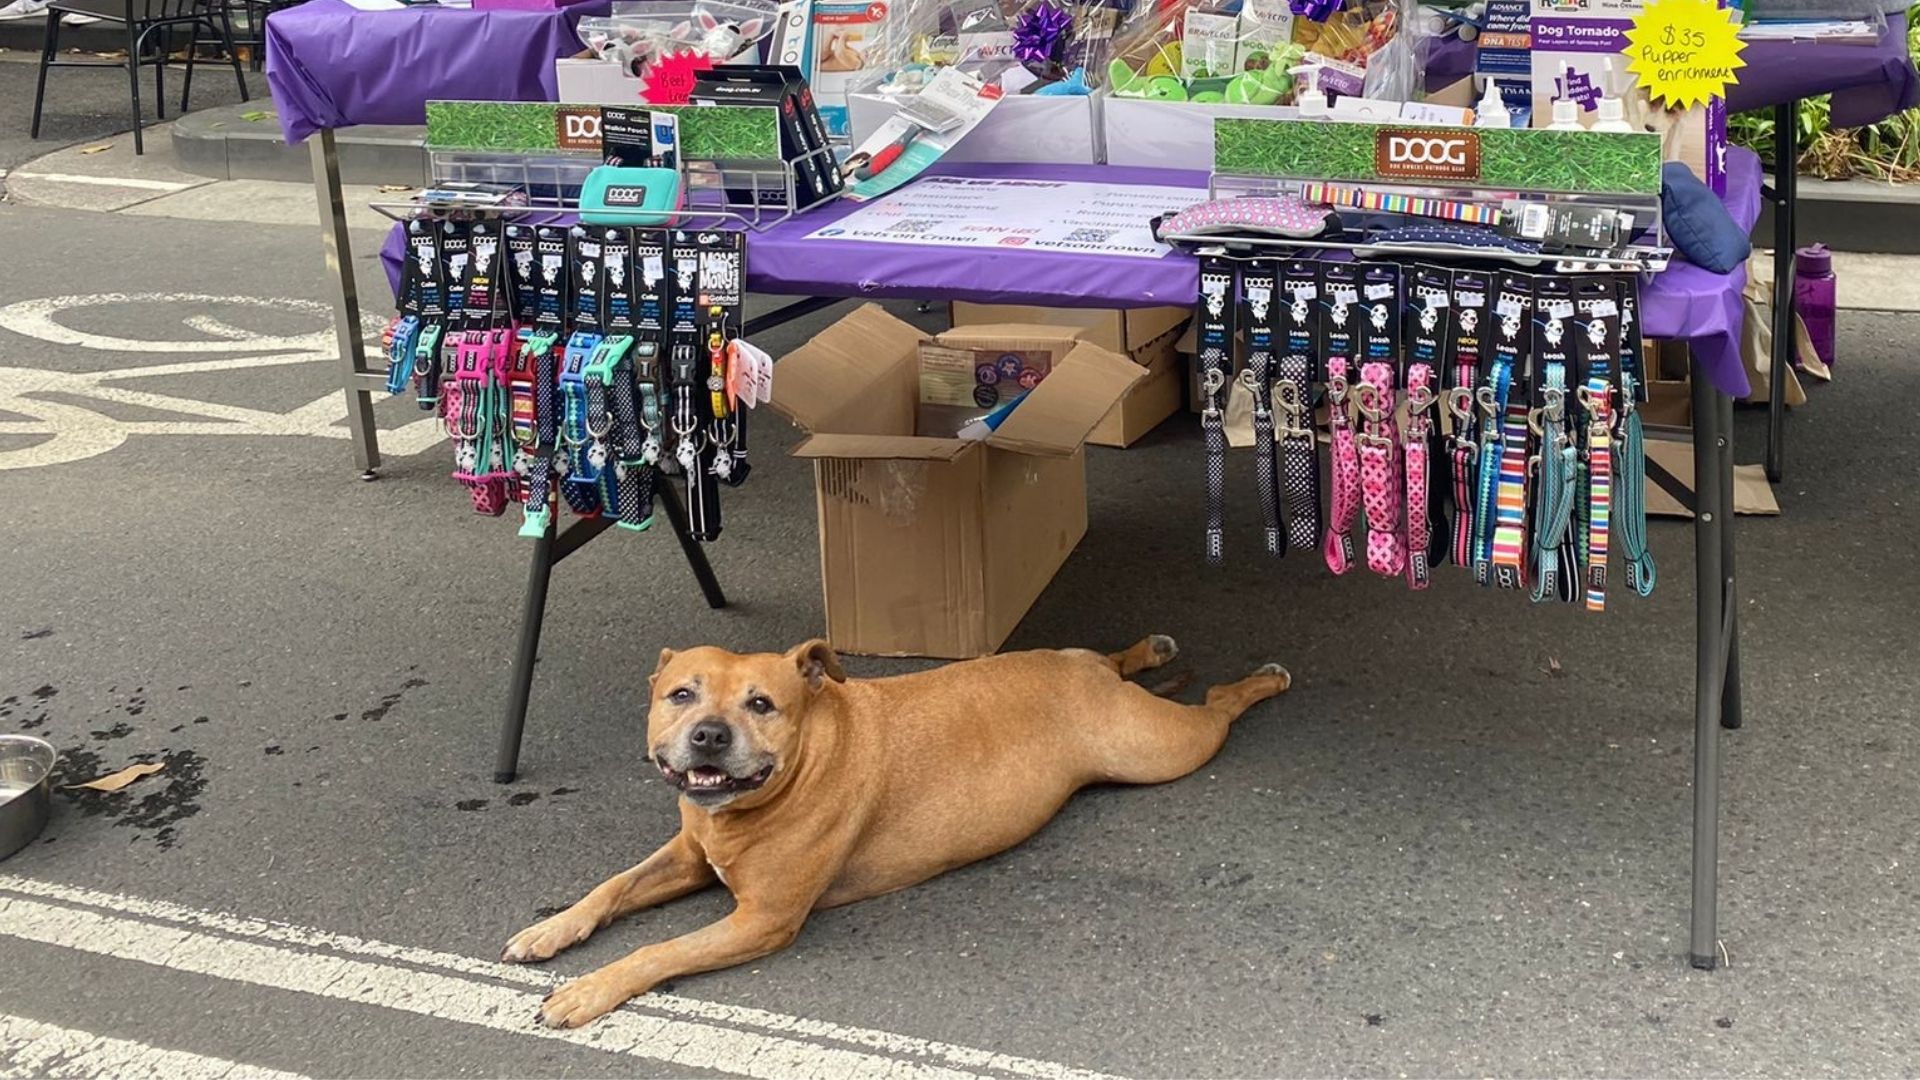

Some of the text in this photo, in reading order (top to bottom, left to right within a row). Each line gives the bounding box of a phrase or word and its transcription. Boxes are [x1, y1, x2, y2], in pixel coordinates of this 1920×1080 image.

[1489, 14, 1515, 22] Where
[1538, 25, 1619, 37] Dog Tornado
[1483, 37, 1505, 46] DNA
[1643, 45, 1697, 65] Pupper
[1657, 67, 1730, 81] enrichment
[604, 124, 648, 135] Walkie Pouch
[1389, 137, 1466, 165] DOOG
[609, 188, 642, 199] DOOG
[411, 236, 434, 247] DOOG
[852, 230, 888, 238] Vets
[919, 233, 978, 243] Crown
[444, 240, 467, 249] DOOG
[539, 241, 565, 253] DOOG
[605, 245, 629, 255] DOOG
[1034, 239, 1157, 254] vetsoncrown
[639, 246, 663, 257] DOOG
[673, 248, 697, 259] DOOG
[1202, 273, 1231, 287] DOOG
[1244, 277, 1274, 288] DOOG
[1500, 291, 1532, 309] DOOG
[1205, 322, 1225, 331] Leash
[1251, 326, 1271, 334] Leash
[1289, 330, 1310, 338] Leash
[1329, 331, 1350, 340] Leash
[1369, 335, 1391, 344] Leash
[1416, 336, 1437, 347] Leash
[1457, 345, 1479, 354] Leash
[1496, 342, 1519, 355] Leash
[1543, 351, 1566, 360] Leash
[1588, 353, 1611, 361] Leash
